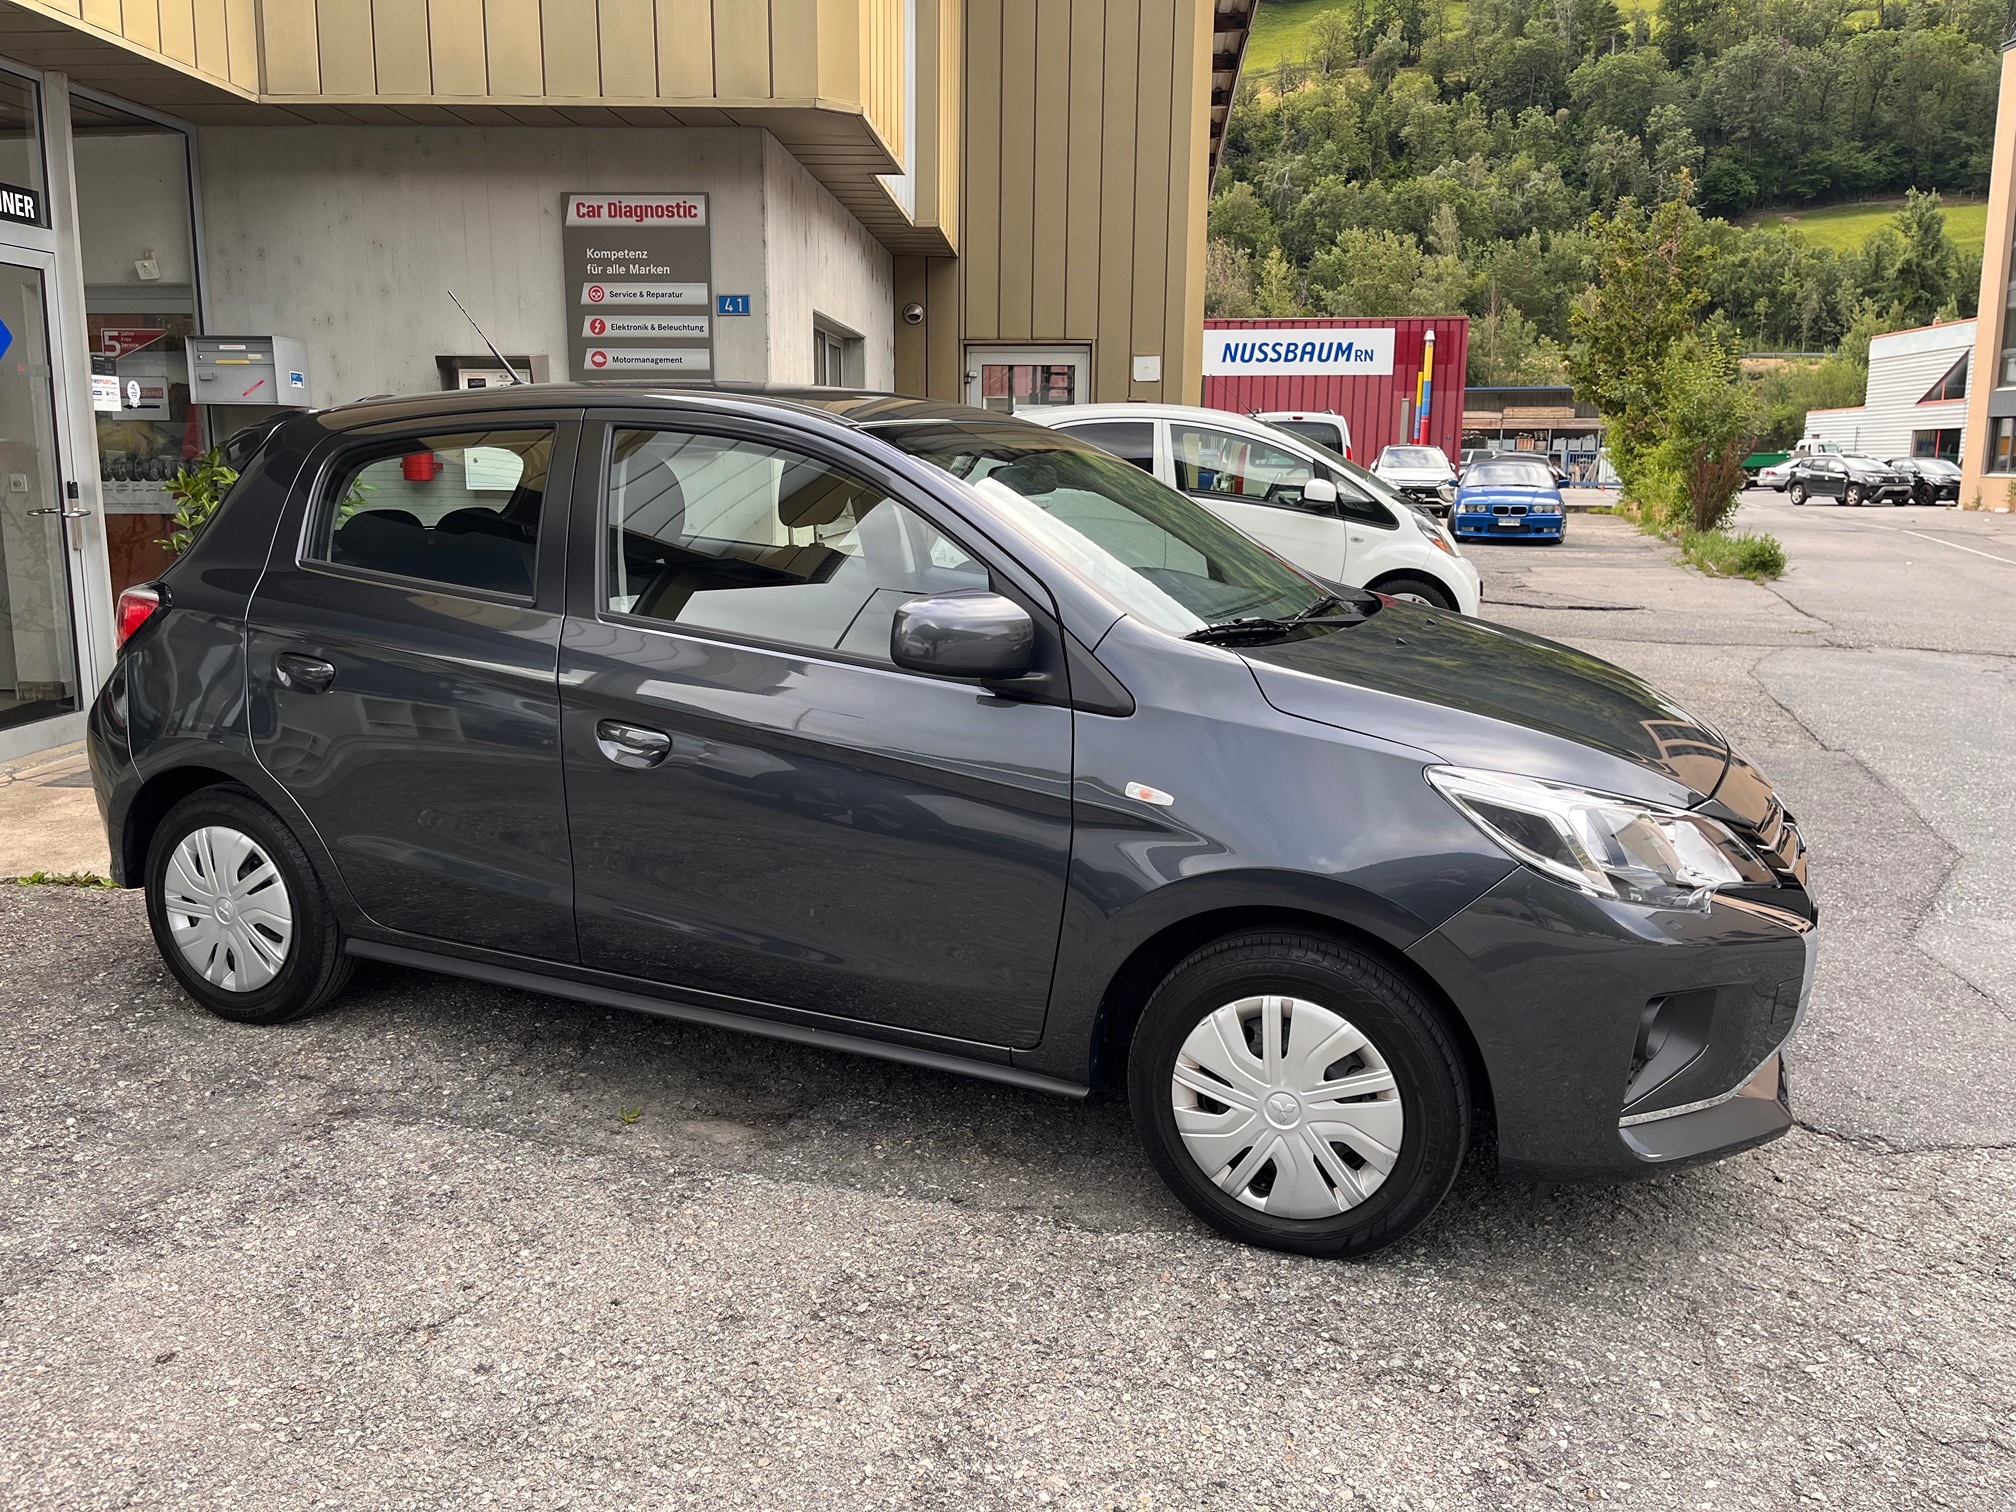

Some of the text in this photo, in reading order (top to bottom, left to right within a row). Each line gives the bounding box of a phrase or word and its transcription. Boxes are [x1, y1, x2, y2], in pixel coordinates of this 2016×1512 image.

[0, 190, 35, 218] NER
[575, 200, 698, 222] Car Diagnostic
[586, 248, 648, 261] Kompetenz
[586, 263, 670, 274] für alle Marken
[609, 290, 683, 299] Service & Reparatur
[724, 297, 743, 312] 41
[611, 323, 705, 333] Elektronik & Beleuchtung
[103, 331, 121, 356] 5
[1221, 341, 1354, 363] NUSSBAUM
[612, 356, 683, 365] Motormanagement
